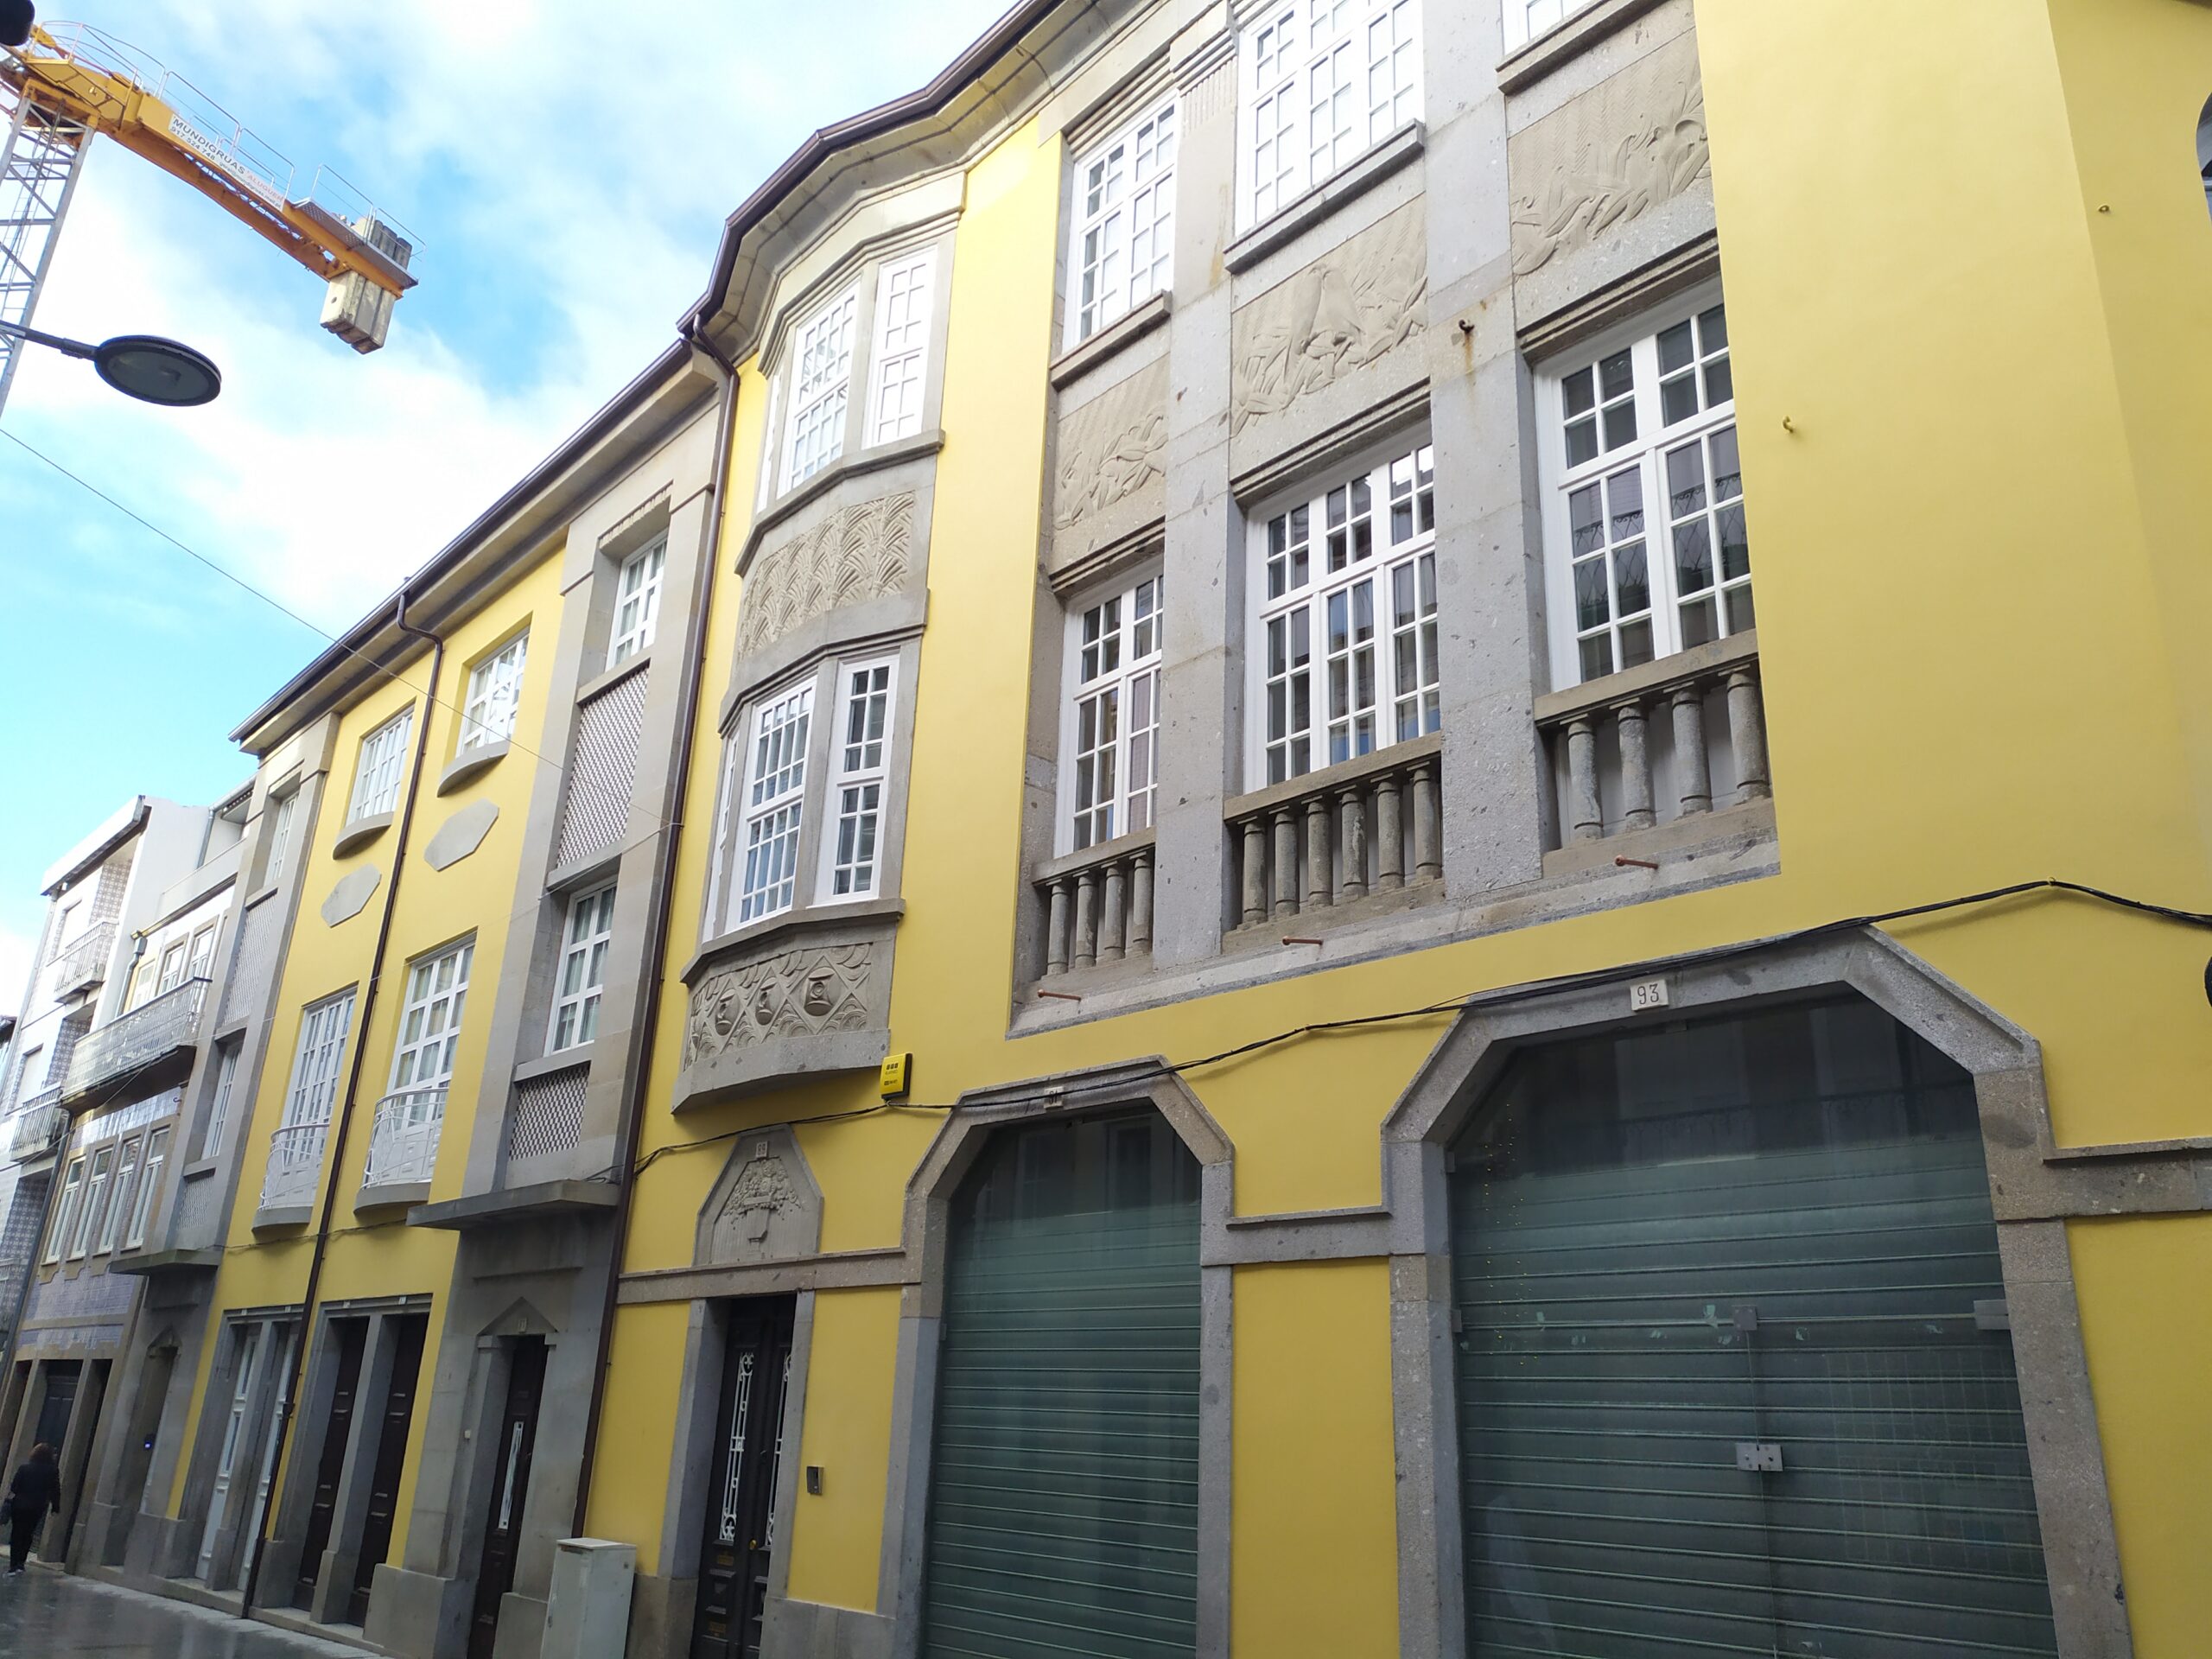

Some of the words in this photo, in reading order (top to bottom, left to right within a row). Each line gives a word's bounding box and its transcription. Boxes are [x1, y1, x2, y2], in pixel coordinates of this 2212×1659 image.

[169, 126, 185, 138] 917
[186, 137, 200, 149] 524
[1637, 983, 1659, 1005] 93
